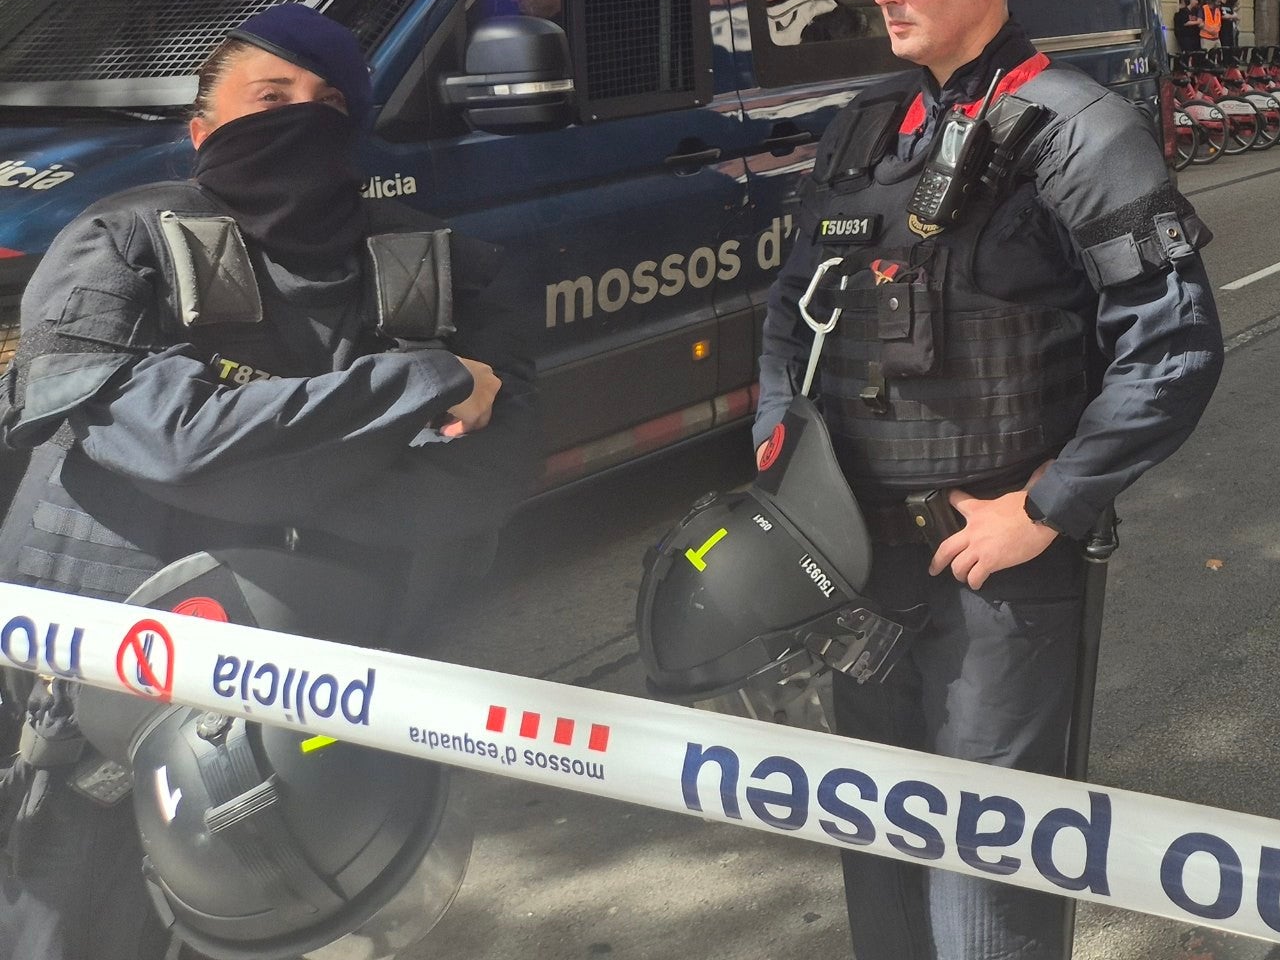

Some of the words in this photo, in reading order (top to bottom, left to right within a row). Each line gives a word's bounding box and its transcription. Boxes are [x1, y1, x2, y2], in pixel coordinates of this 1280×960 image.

[1124, 56, 1149, 76] T-131
[821, 218, 869, 237] T5U931
[546, 240, 741, 328] mossos
[752, 513, 773, 532] 0541
[1, 615, 86, 678] no
[213, 653, 377, 726] policia
[409, 726, 517, 766] d'esquadra
[524, 748, 605, 780] mossos
[681, 741, 1113, 897] passeu
